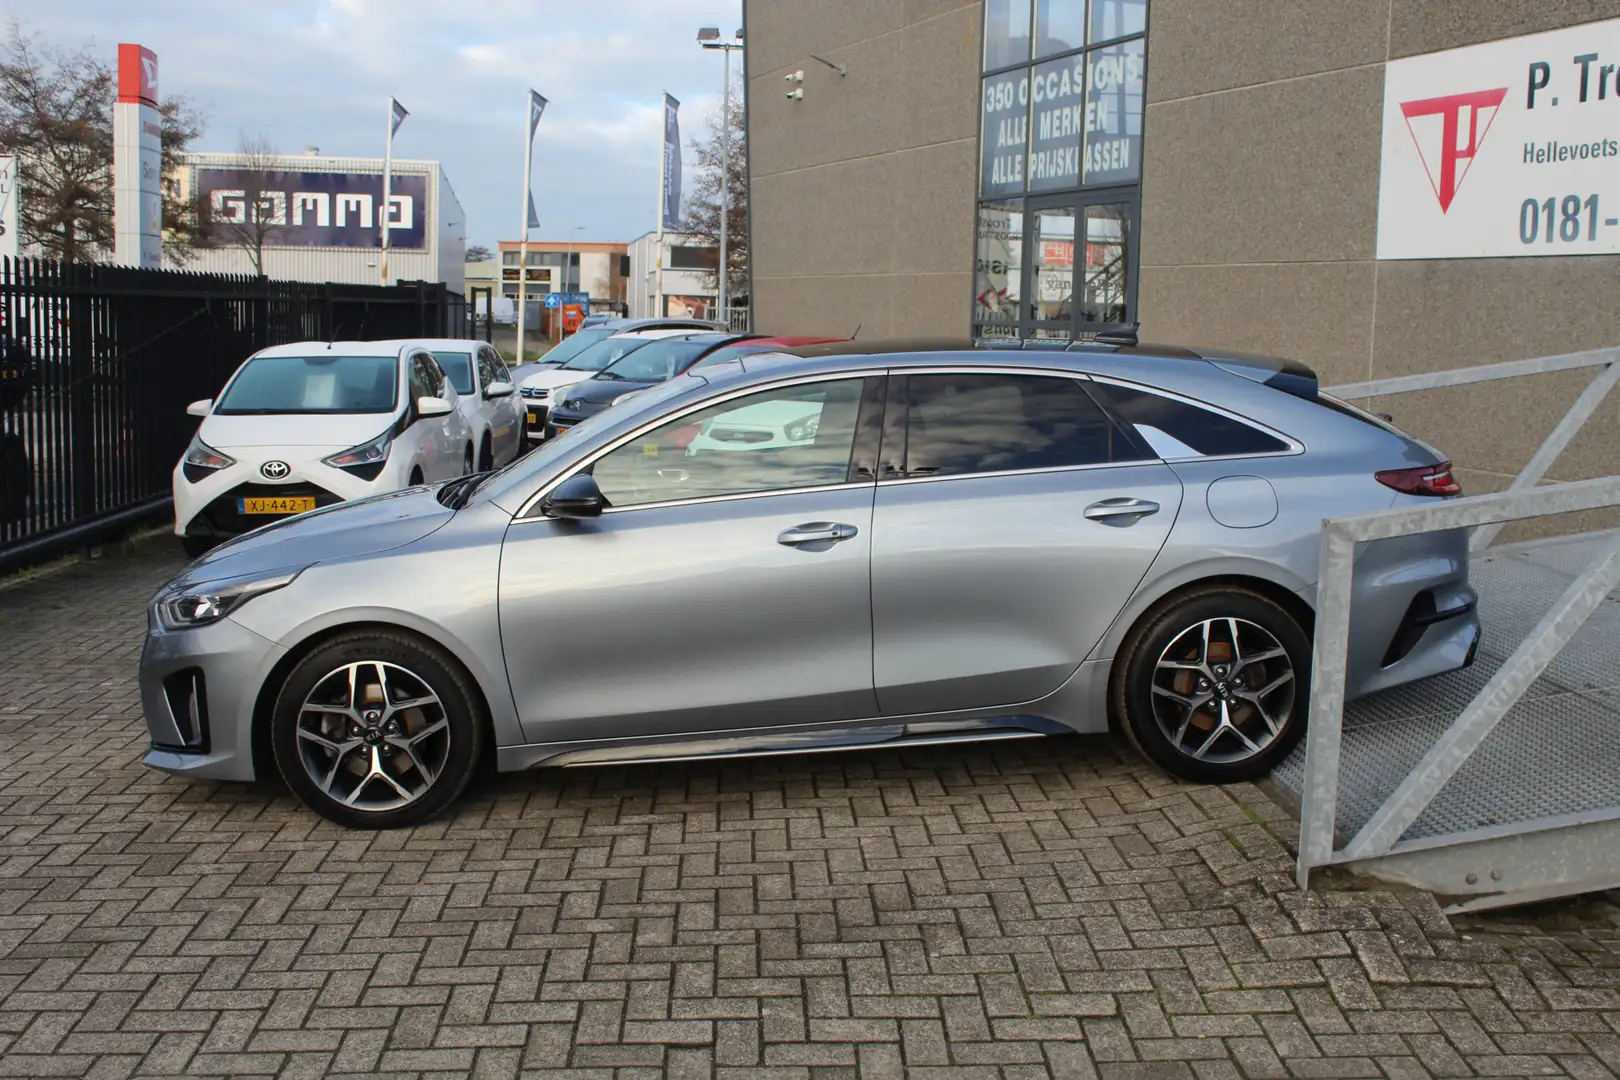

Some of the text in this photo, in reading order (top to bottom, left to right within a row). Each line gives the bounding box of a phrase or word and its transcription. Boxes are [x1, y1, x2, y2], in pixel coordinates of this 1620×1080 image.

[986, 52, 1138, 113] 350 OCCASIONS
[1526, 52, 1620, 110] P. Tr
[1040, 100, 1108, 141] MERKEN
[1523, 138, 1620, 164] Hellevoets
[992, 154, 1022, 185] ALLE
[250, 499, 309, 512] XJ-442-T
[365, 730, 382, 743] KIA
